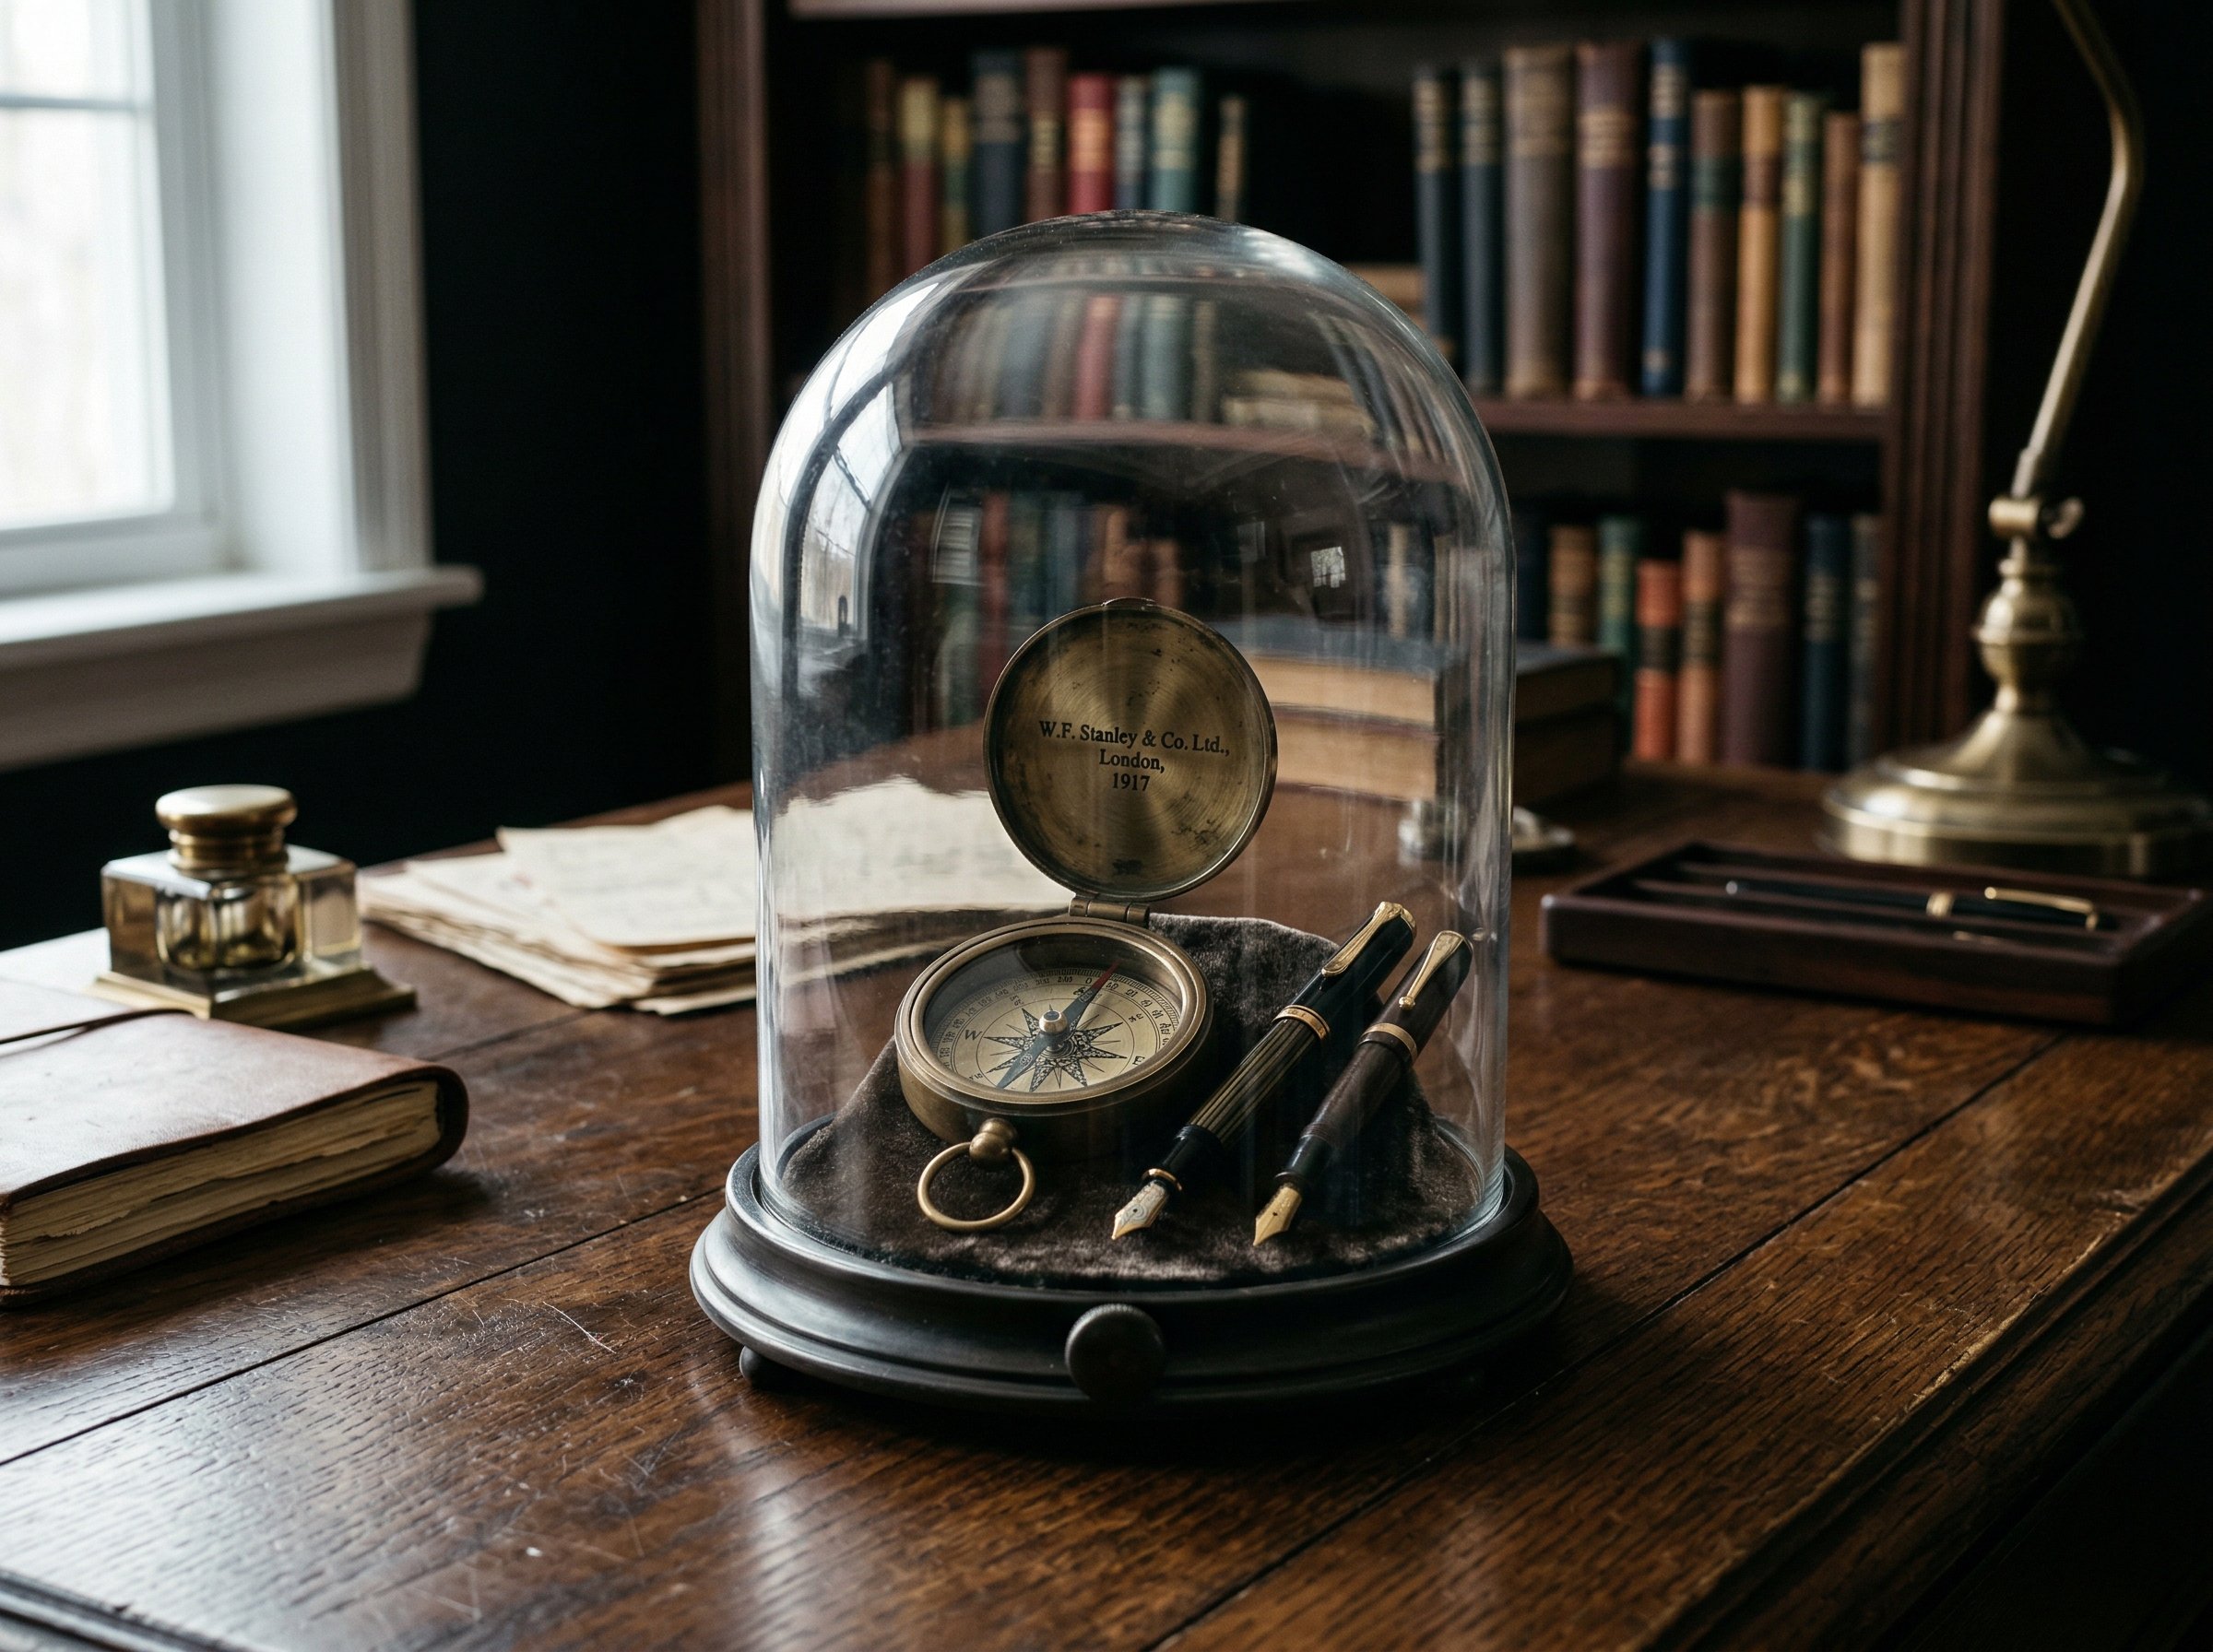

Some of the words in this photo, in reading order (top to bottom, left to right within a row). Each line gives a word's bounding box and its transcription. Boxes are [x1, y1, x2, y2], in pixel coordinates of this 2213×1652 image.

[1039, 721, 1075, 739] W.F.
[1080, 725, 1138, 749] Stanley
[1142, 730, 1156, 747] &
[1161, 731, 1188, 749] Co.
[1192, 734, 1230, 756] Ltd.,
[1099, 749, 1165, 773] London,
[1112, 773, 1150, 791] 1917
[964, 1029, 983, 1040] W
[1131, 1056, 1145, 1065] E
